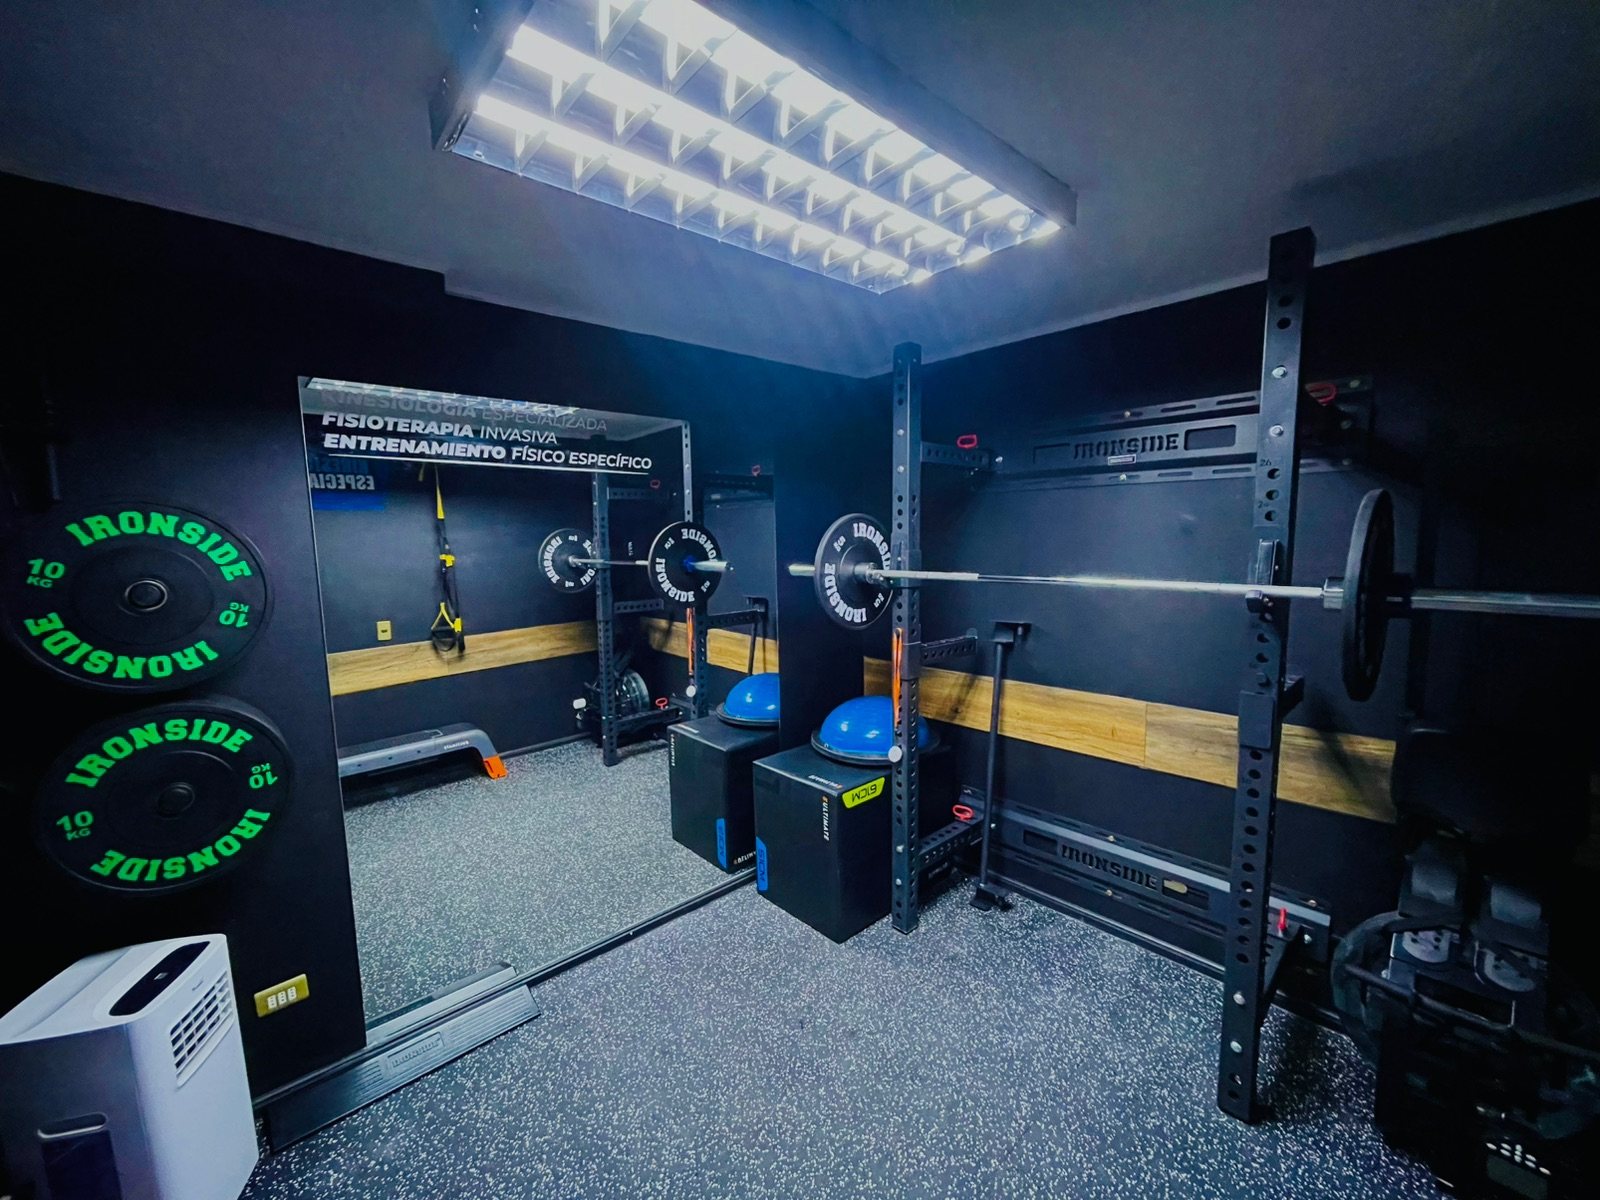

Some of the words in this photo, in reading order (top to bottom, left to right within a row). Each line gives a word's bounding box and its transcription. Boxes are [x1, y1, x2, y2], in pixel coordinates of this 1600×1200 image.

[322, 411, 474, 438] FISIOTERAPIA
[480, 425, 558, 445] INVASIVA
[323, 433, 506, 460] ENTRENAMIENTO
[511, 445, 566, 464] FÍSICO
[568, 452, 653, 470] ESPECÍFICO
[1074, 433, 1180, 460] IRONSIDE
[65, 511, 253, 583] IRONSIDE
[26, 576, 52, 588] KG
[27, 558, 65, 579] 10
[824, 563, 867, 623] IRONSIDE
[219, 609, 249, 628] 10
[229, 602, 249, 613] KG
[24, 612, 219, 680] IRONSIDE
[65, 719, 253, 789] IRONSIDE
[248, 770, 278, 789] 10
[251, 762, 272, 774] KG
[851, 783, 877, 803] 61CM
[56, 810, 94, 831] 10
[66, 827, 92, 841] KG
[822, 803, 830, 841] ULTIMATE
[90, 808, 271, 883] IRONSIDE
[1062, 845, 1159, 890] IRONSIDE
